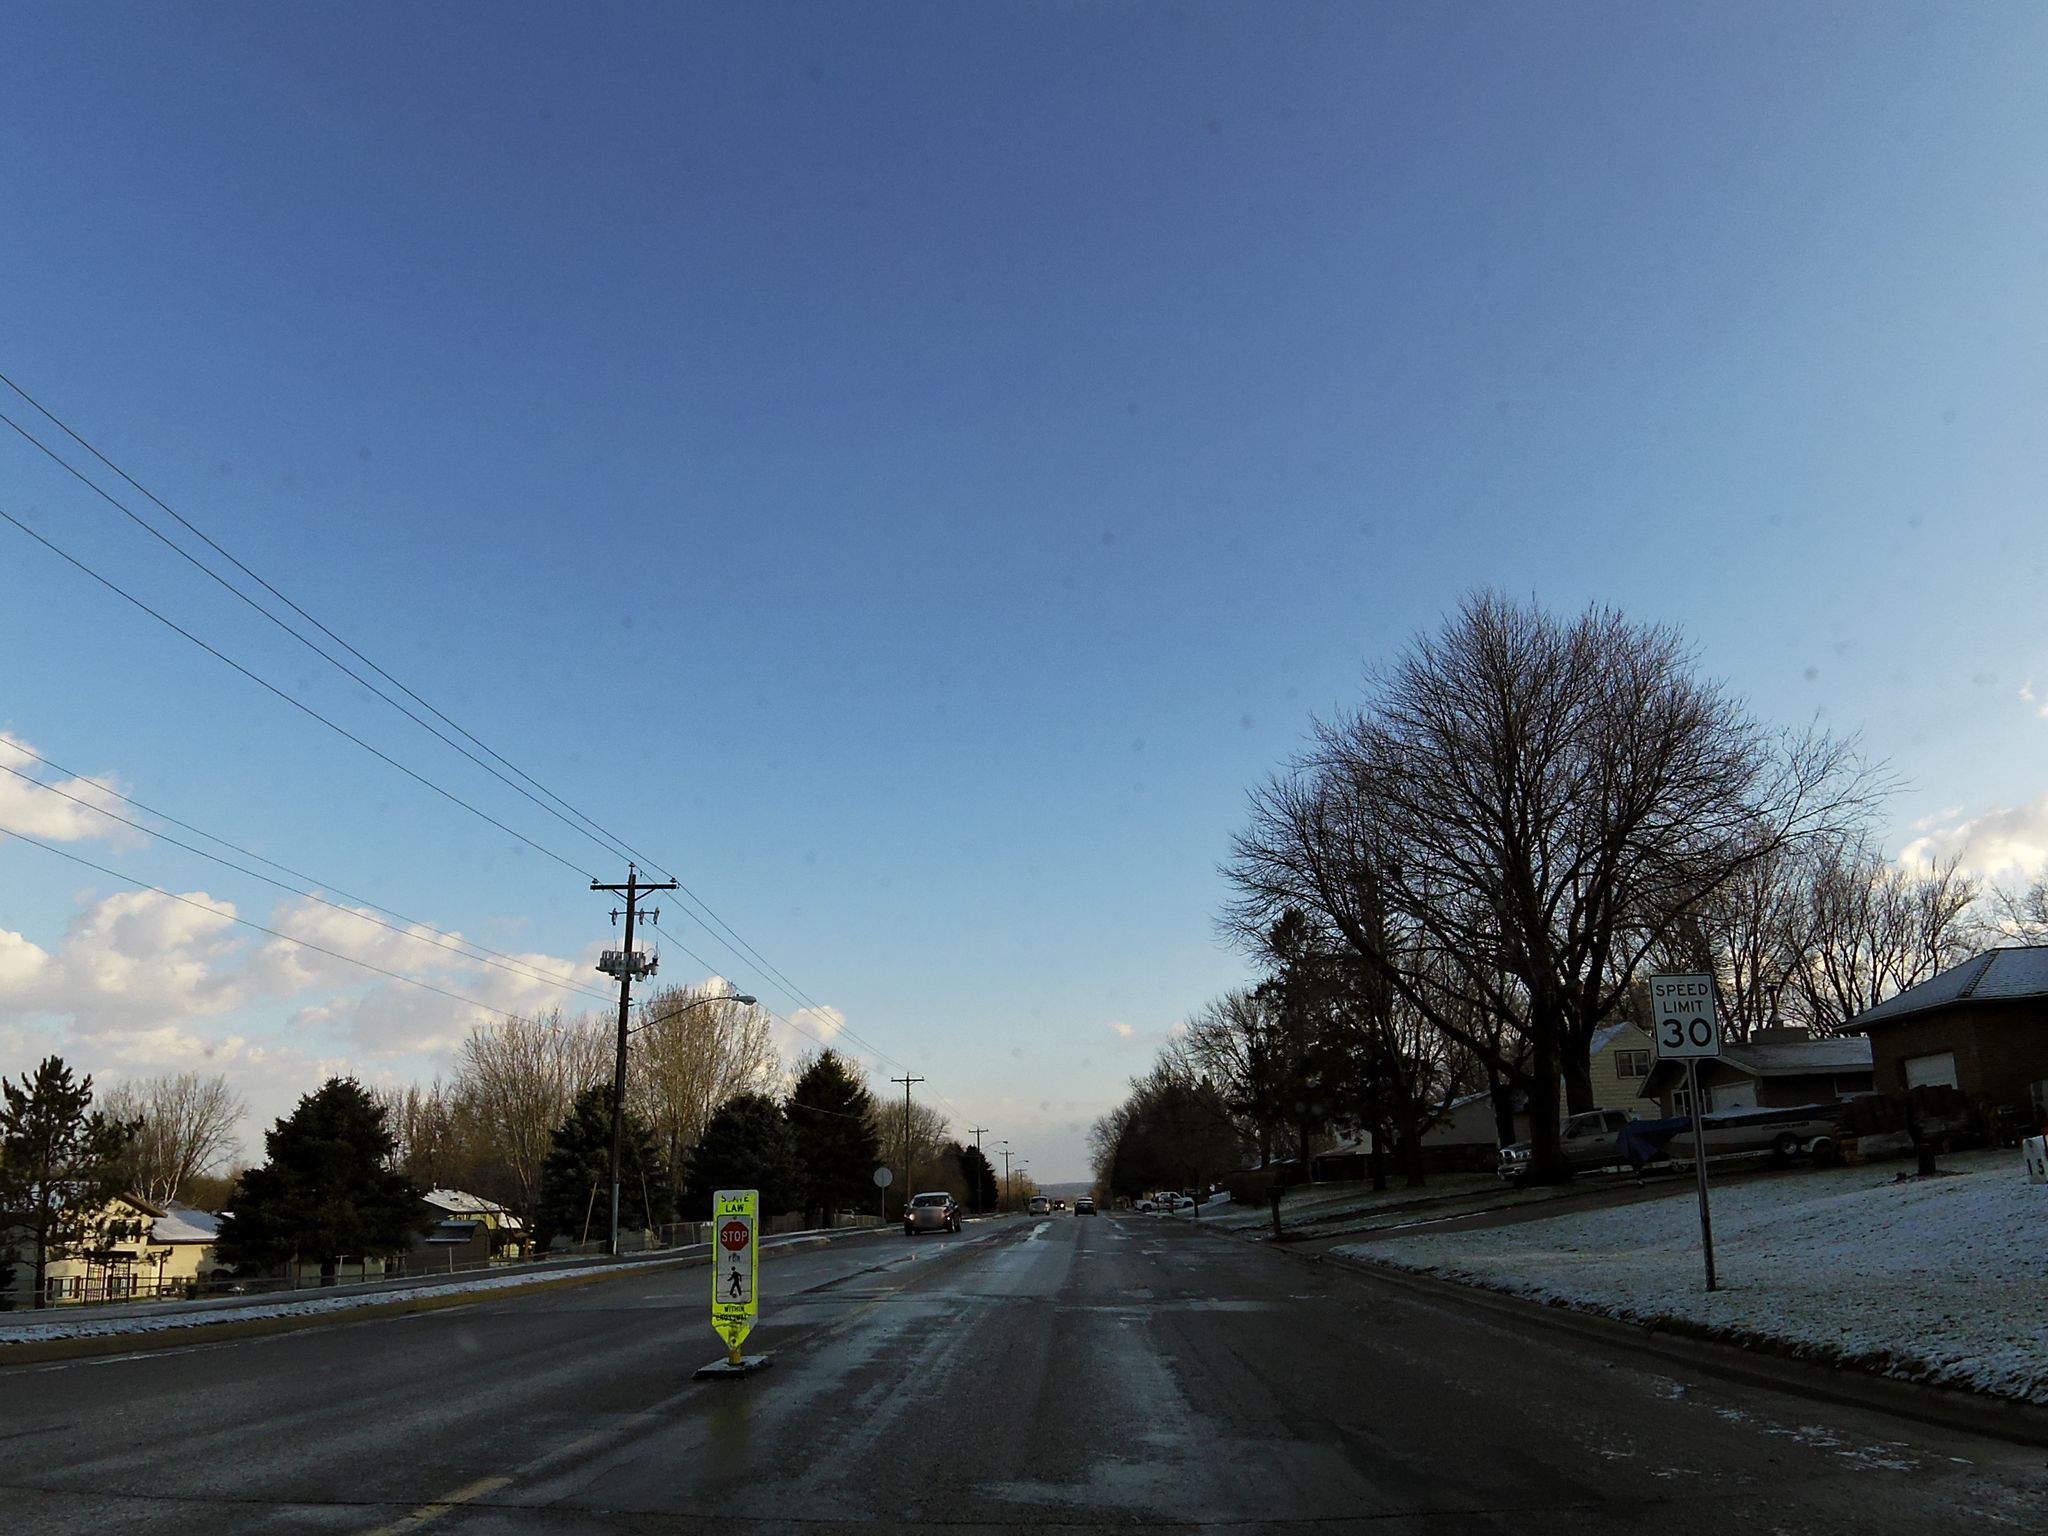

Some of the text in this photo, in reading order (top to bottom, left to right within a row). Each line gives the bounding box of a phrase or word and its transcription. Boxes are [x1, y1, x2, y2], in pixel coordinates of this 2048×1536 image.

[1655, 983, 1708, 997] SPEED
[1663, 1000, 1704, 1013] LIMIT
[1662, 1018, 1712, 1048] 30
[726, 1203, 745, 1213] LAW
[721, 1230, 748, 1243] STOP
